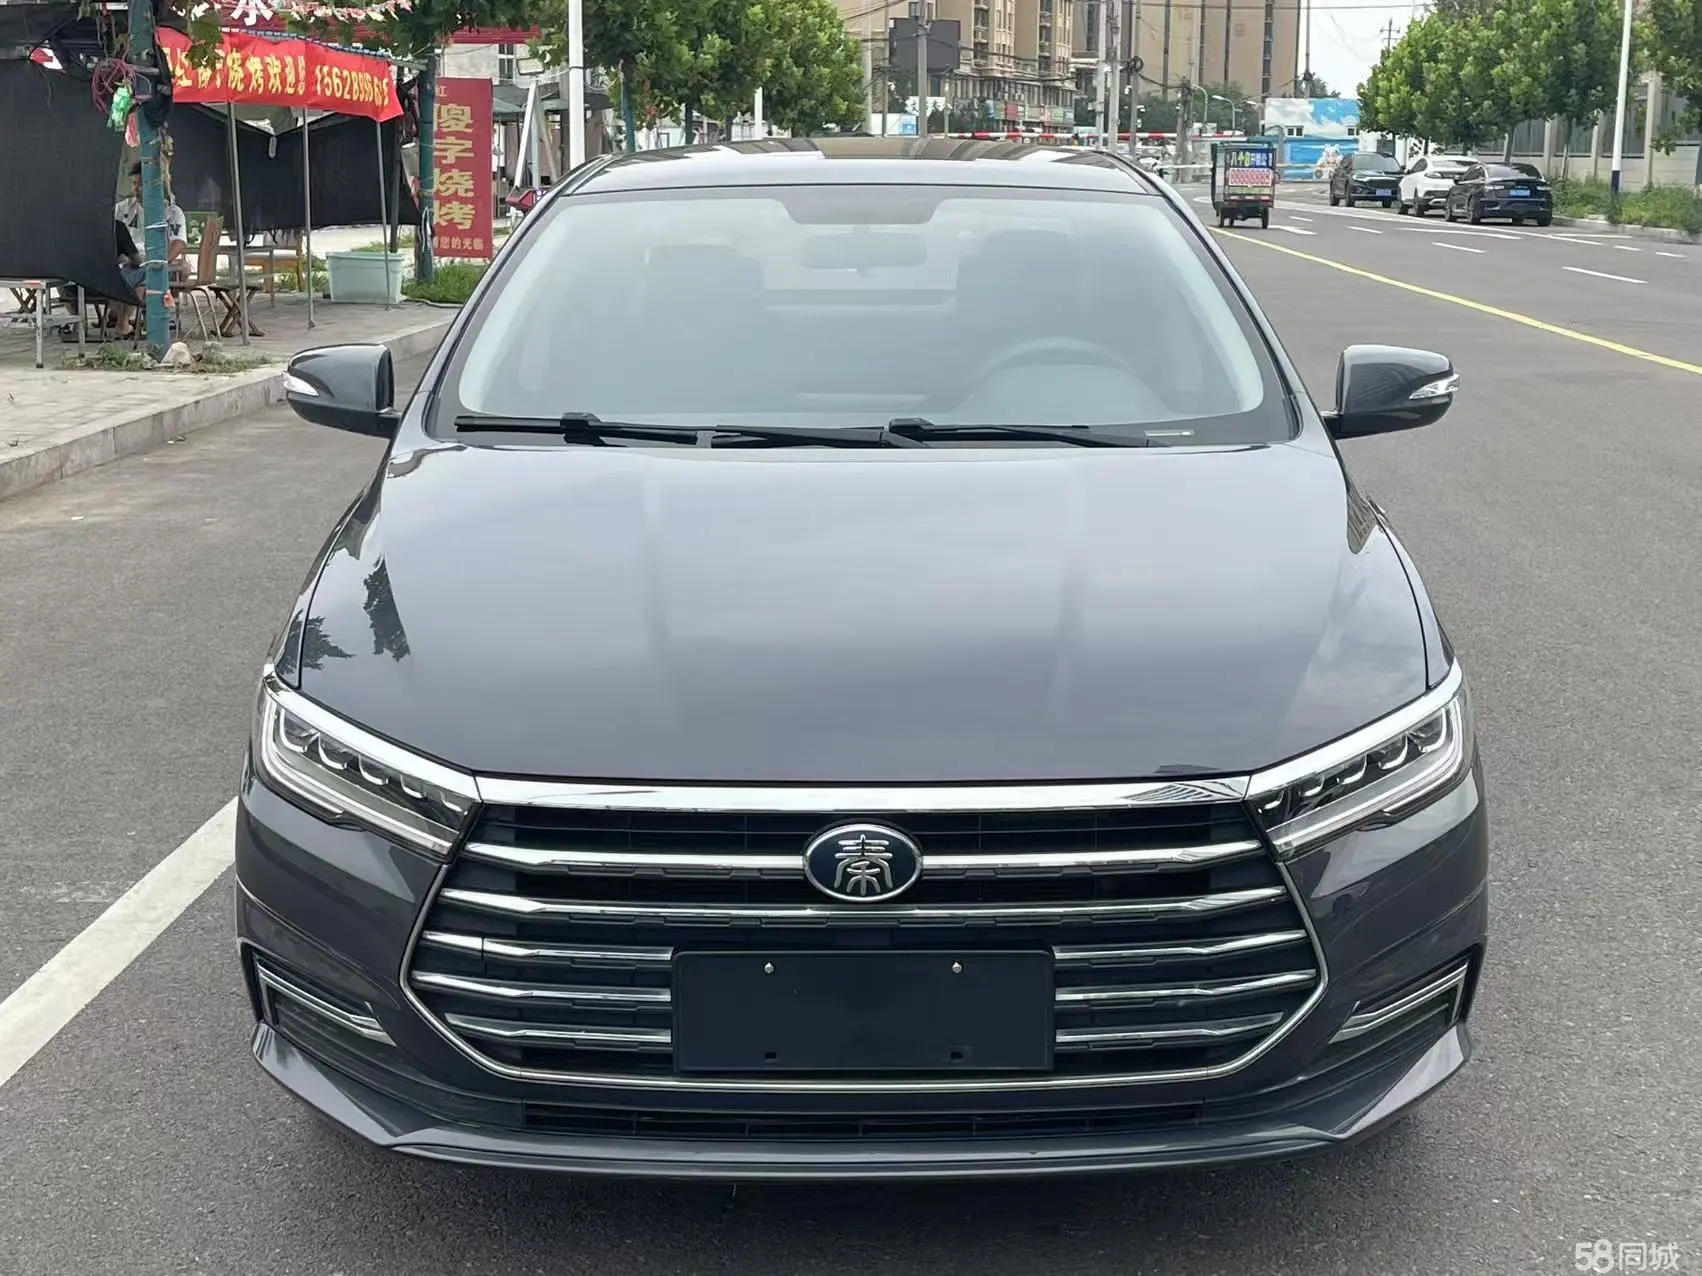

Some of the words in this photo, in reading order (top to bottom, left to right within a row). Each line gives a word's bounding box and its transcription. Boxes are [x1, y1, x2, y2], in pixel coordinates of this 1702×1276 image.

[433, 236, 484, 250] 您的光临
[834, 833, 893, 896] 秦
